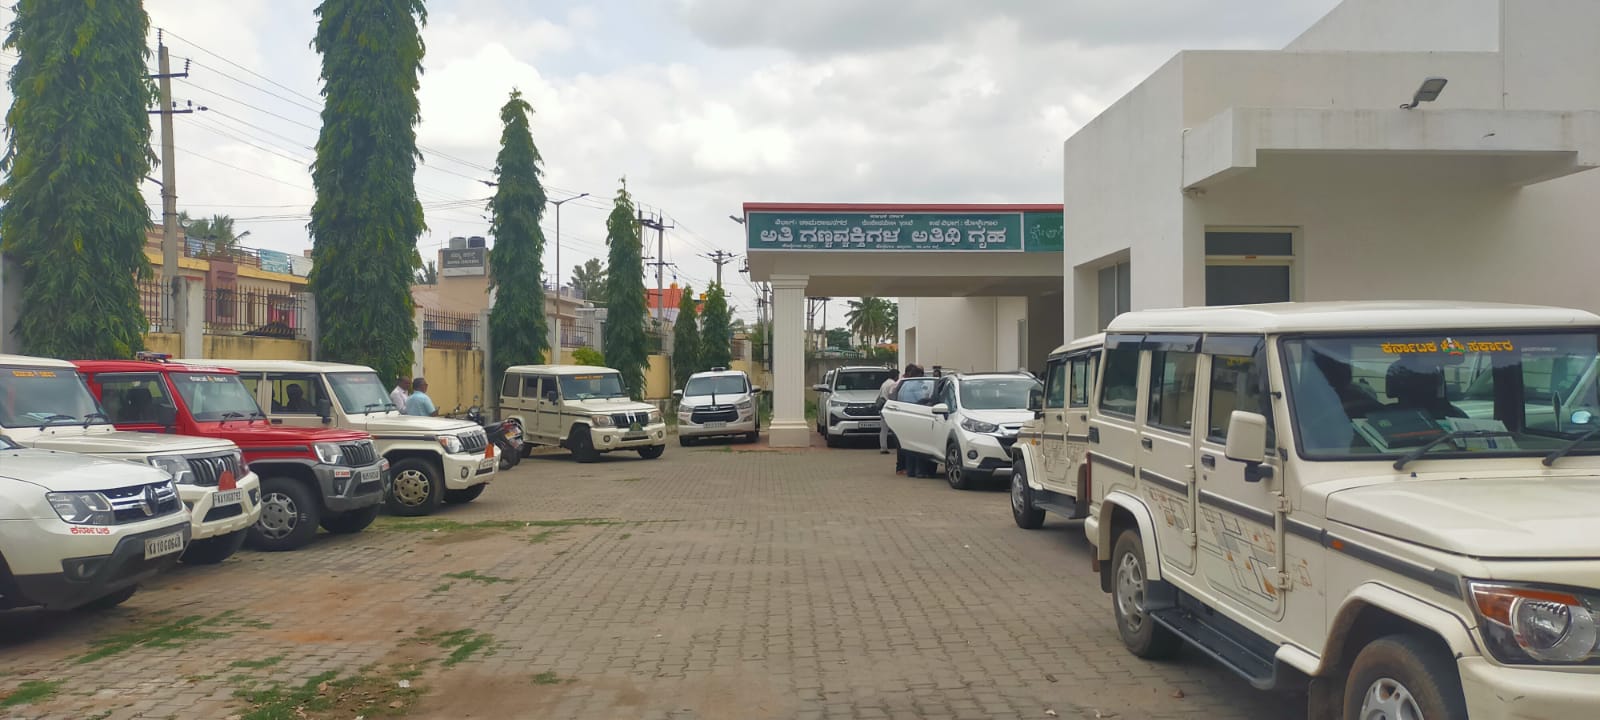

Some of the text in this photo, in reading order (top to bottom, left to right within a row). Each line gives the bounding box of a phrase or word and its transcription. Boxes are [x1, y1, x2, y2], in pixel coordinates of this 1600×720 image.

[761, 227, 794, 242] ಅತಿ
[799, 226, 901, 248] ಗಣ್ಯವ್ಯಕ್ತಿಗಳ
[912, 227, 961, 246] ಅತಿಥಿ
[968, 227, 1007, 249] ಗೃಹ
[1381, 342, 1438, 354] ಕರ್ನಾಟಕ
[1467, 339, 1514, 352] ಸರ್ಕಾರ
